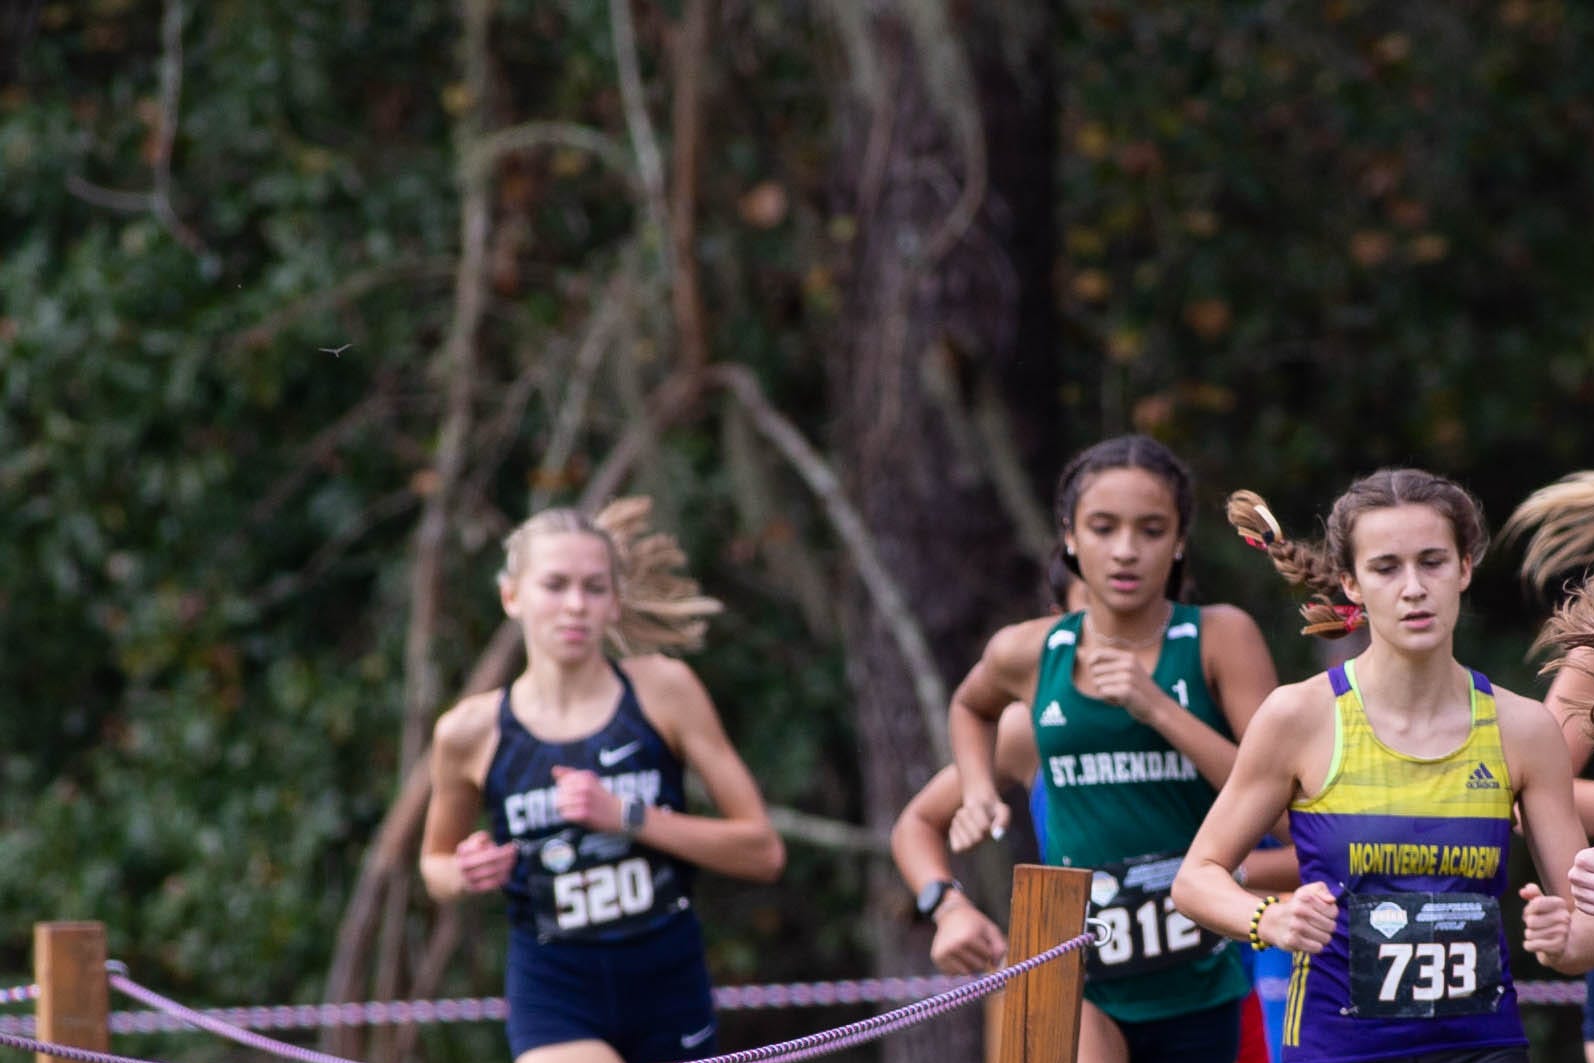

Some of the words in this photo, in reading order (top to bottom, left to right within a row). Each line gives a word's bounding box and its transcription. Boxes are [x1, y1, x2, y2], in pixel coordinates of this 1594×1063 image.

[1349, 843, 1438, 876] MONTVERDE
[1438, 845, 1501, 879] ACADEMY
[553, 857, 655, 930] 520
[1378, 942, 1477, 1002] 733
